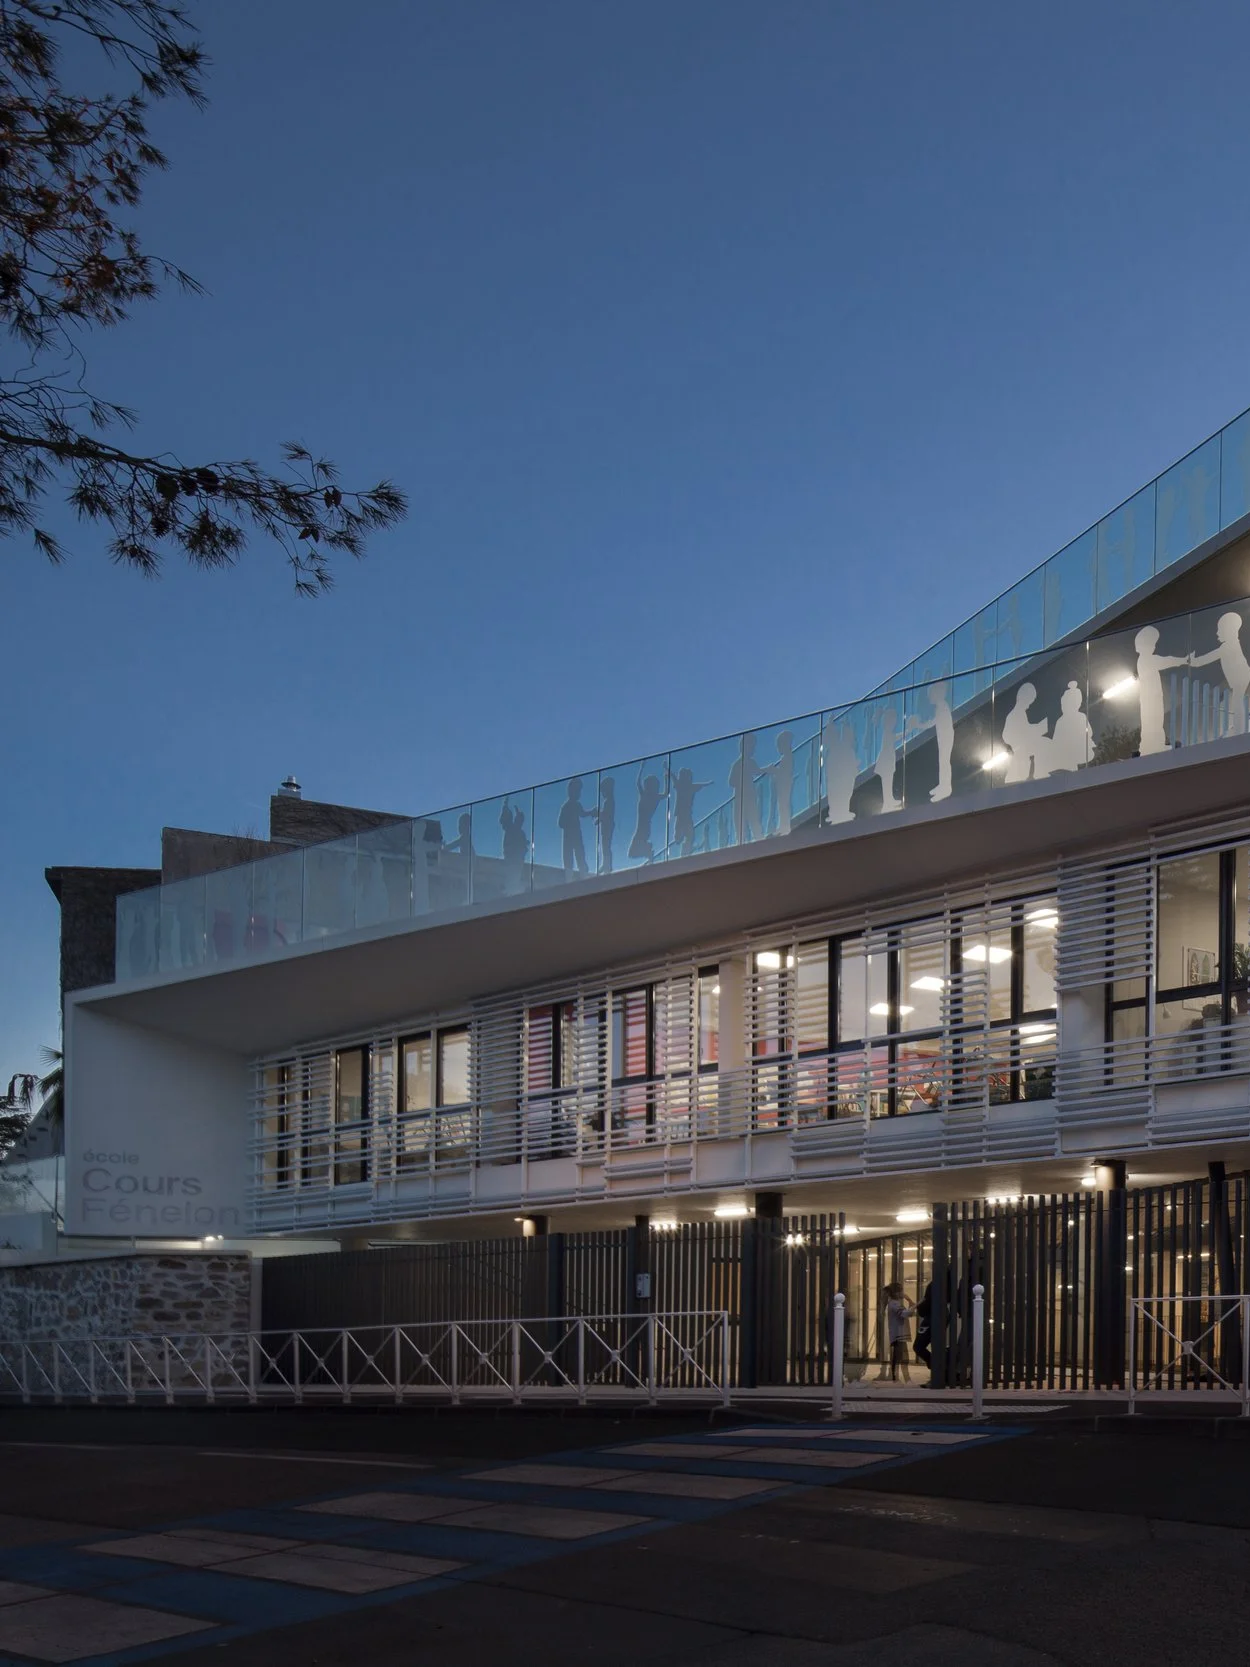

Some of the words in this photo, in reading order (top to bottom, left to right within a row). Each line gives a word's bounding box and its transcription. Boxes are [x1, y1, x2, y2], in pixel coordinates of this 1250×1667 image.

[82, 1148, 140, 1165] école
[82, 1167, 203, 1196] Cours
[82, 1197, 240, 1226] Fénelon
